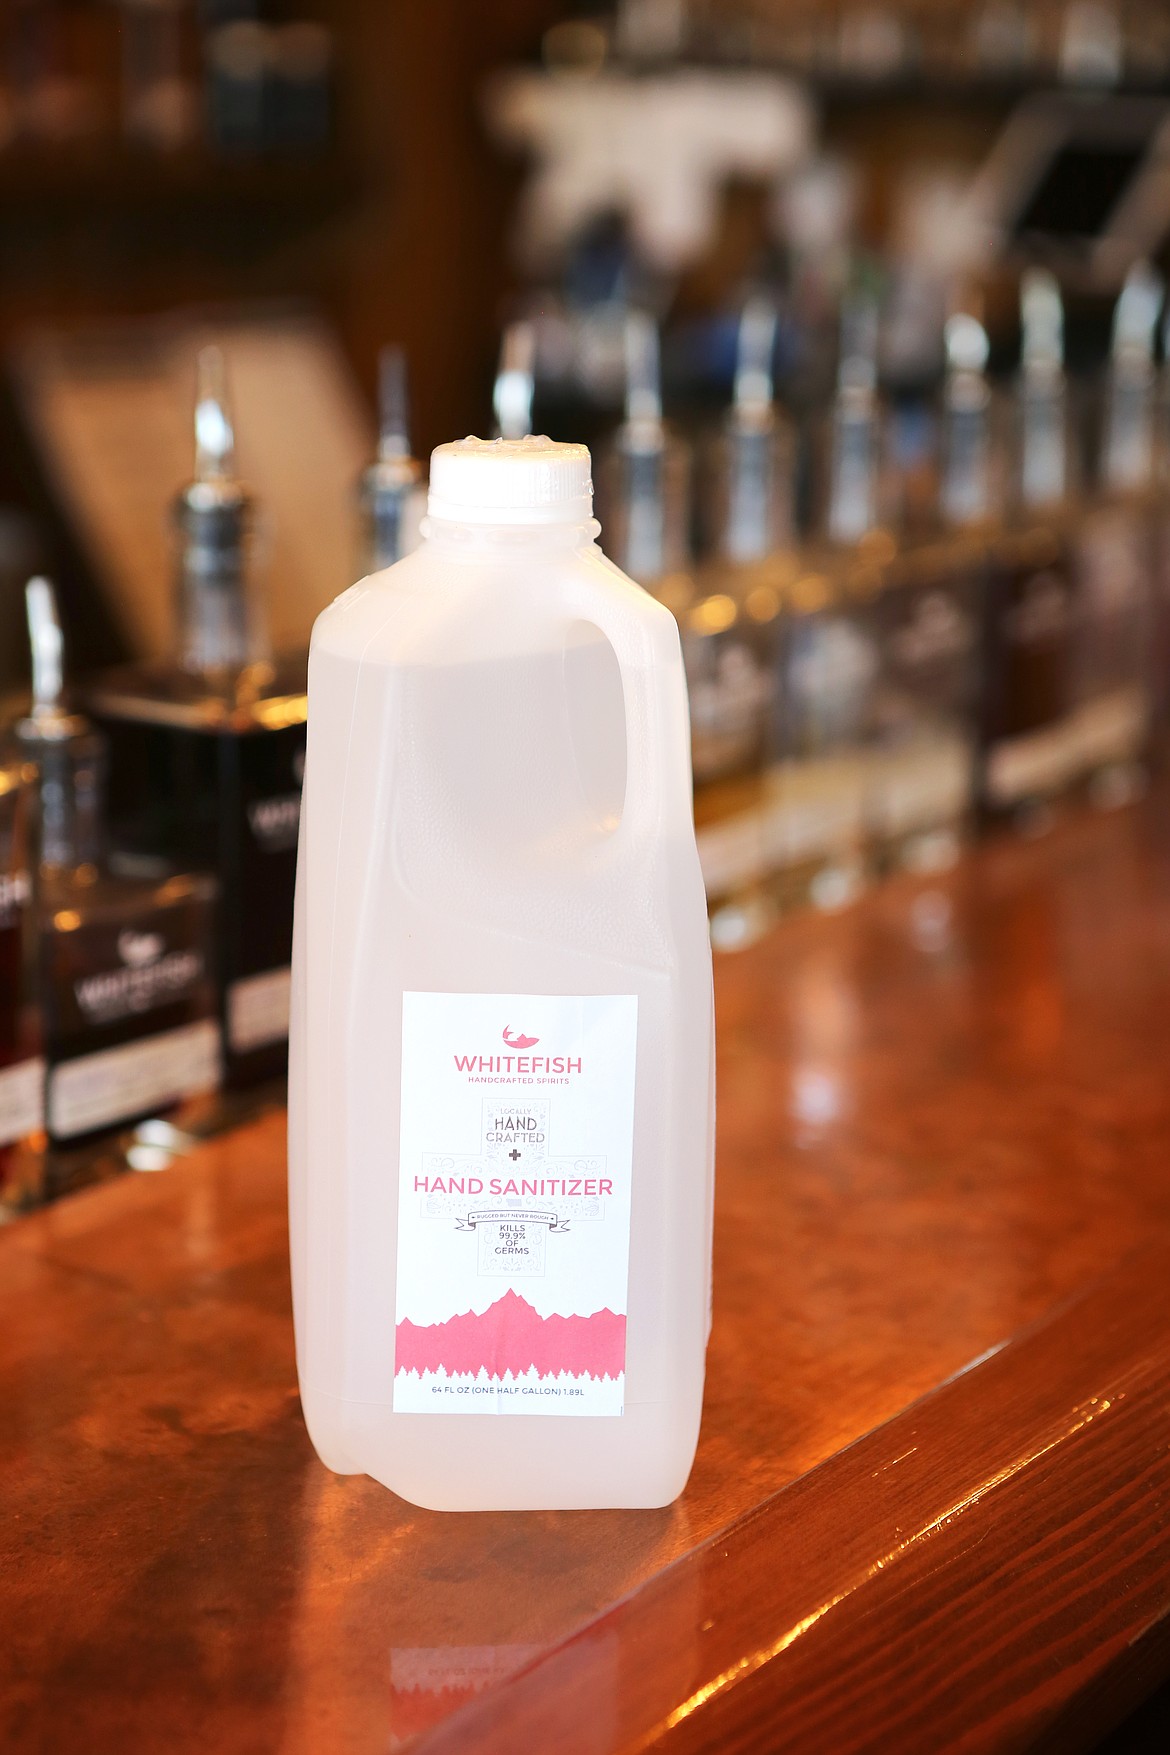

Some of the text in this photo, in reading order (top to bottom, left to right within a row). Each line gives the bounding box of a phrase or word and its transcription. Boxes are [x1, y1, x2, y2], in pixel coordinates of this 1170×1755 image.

[454, 1055, 582, 1074] WHITEFISH
[468, 1076, 570, 1085] HANDCRAFTED SPIRITS
[500, 1107, 532, 1115] LOCALLY
[495, 1115, 538, 1131] HAND
[486, 1132, 545, 1143] CRAFTED
[414, 1175, 613, 1196] HAND SANITIZER
[500, 1224, 526, 1232] KILLS
[494, 1247, 530, 1255] GERMS
[431, 1386, 585, 1396] 64 FL OZ (ONE HALF GALLON) 1.89L
